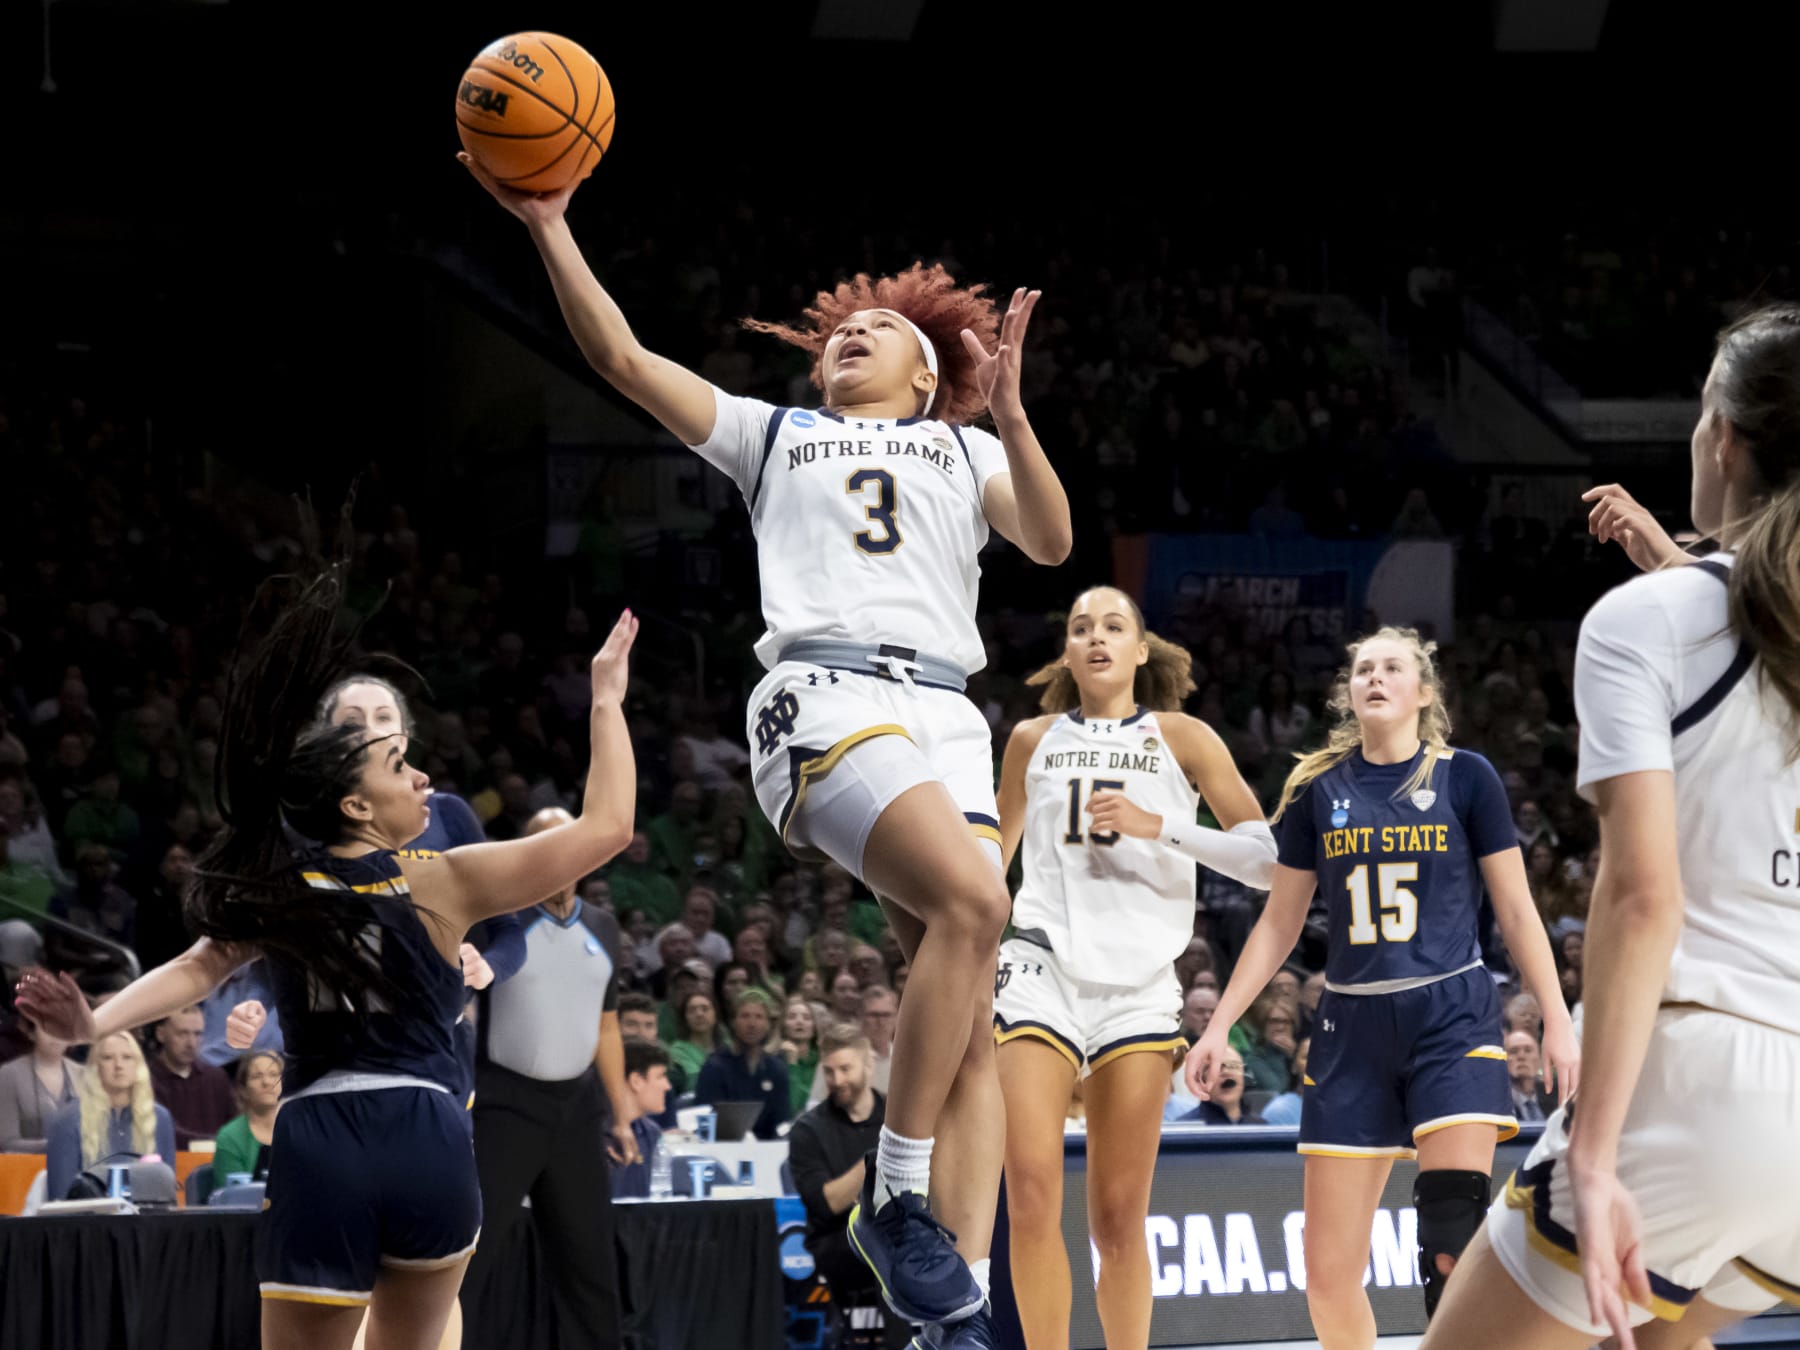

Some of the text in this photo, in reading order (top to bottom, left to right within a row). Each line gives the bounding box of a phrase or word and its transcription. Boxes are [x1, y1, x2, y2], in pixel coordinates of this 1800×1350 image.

[787, 440, 956, 475] NOTRE DAME
[845, 467, 904, 556] 3
[1044, 751, 1161, 774] NOTRE DAME
[1322, 825, 1448, 860] KENT STATE
[1345, 862, 1419, 945] 15
